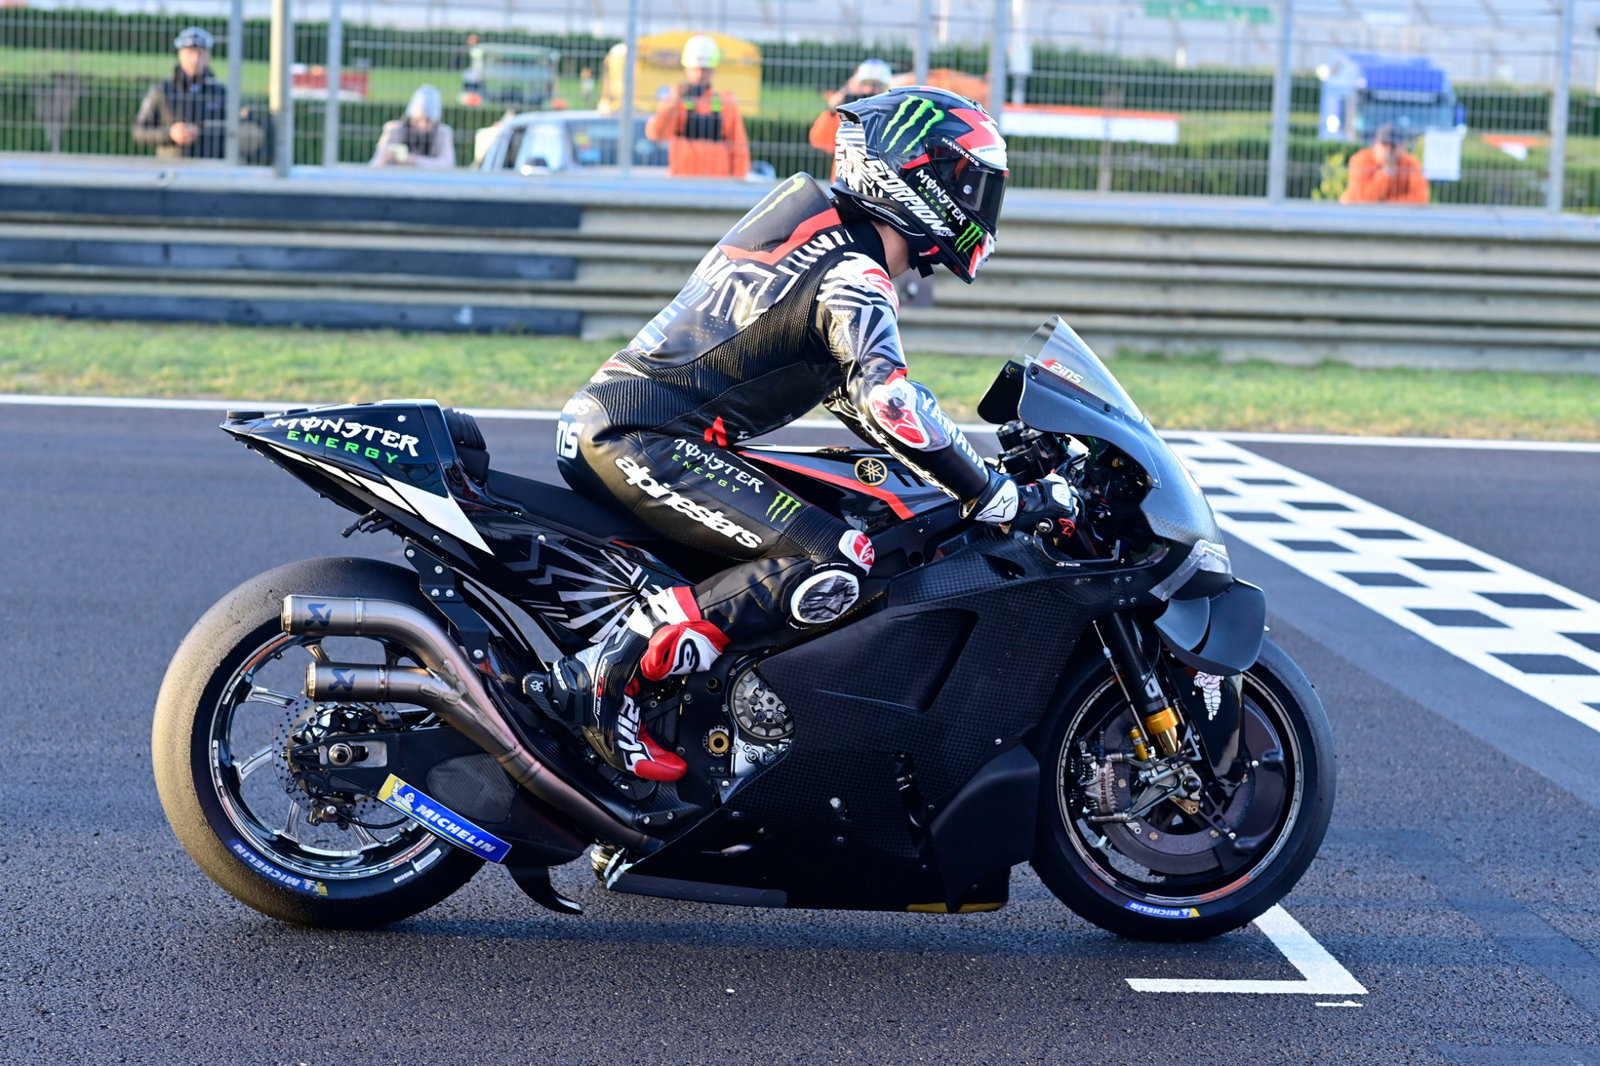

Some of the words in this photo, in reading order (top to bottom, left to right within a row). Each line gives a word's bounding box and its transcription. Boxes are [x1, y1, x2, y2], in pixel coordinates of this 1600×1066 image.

[942, 137, 980, 167] HAWKERS
[863, 158, 952, 232] SCORPION
[916, 169, 967, 226] MONSTER
[917, 185, 953, 223] ENERGY
[272, 416, 419, 457] MONSTER
[287, 430, 399, 464] ENERGY
[672, 454, 741, 493] ENERGY
[615, 456, 763, 548] alpinestars
[415, 804, 497, 853] MICHELIN
[233, 843, 301, 887] MICHELIN
[1130, 902, 1180, 917] MICHELIN
